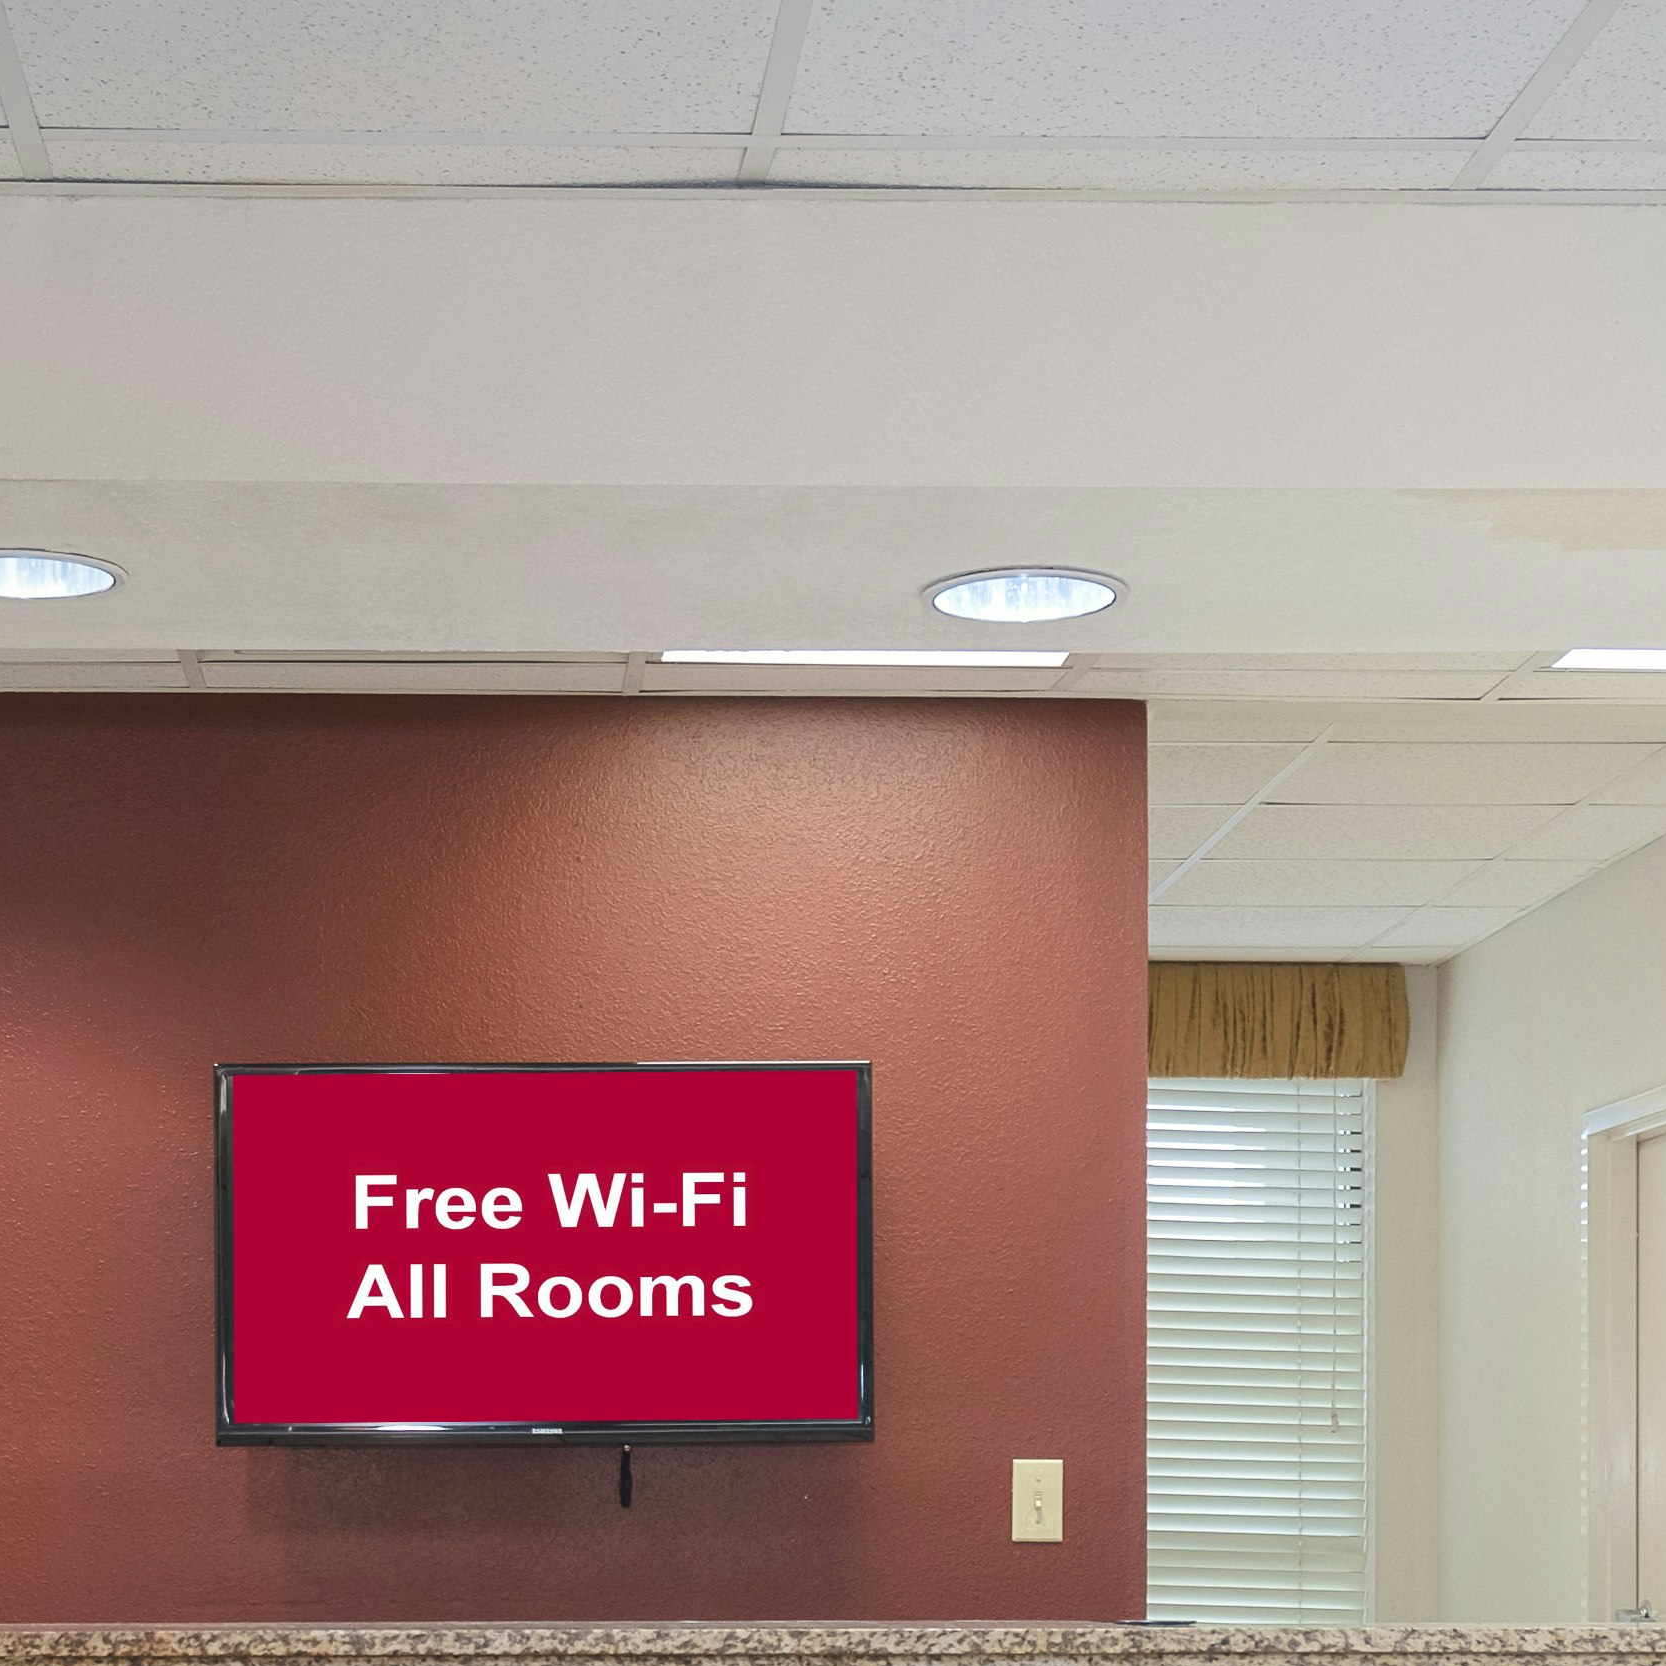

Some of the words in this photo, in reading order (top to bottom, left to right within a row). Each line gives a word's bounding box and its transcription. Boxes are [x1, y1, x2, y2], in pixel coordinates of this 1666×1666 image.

[354, 1172, 523, 1230] Free
[547, 1171, 746, 1228] Wi-Fi
[346, 1263, 447, 1319] All
[479, 1262, 753, 1319] Rooms
